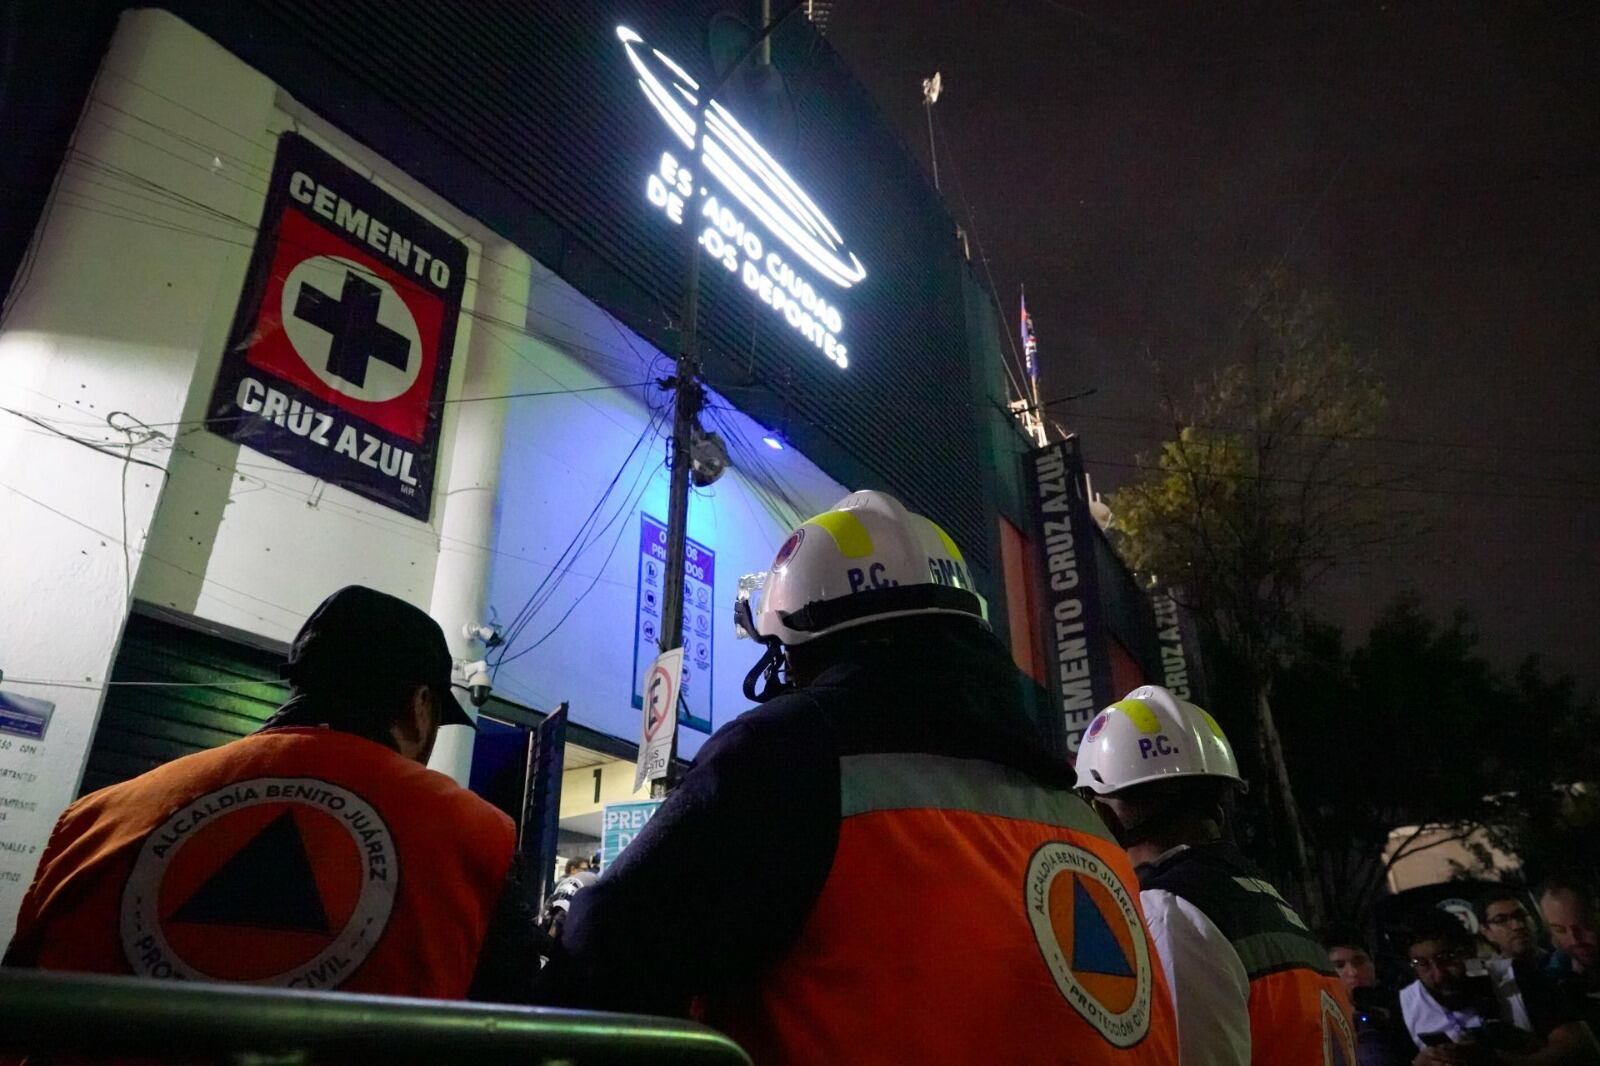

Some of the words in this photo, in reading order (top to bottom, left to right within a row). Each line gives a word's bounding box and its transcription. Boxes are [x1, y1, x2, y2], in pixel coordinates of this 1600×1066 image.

[289, 171, 450, 289] CEMENTO
[660, 152, 763, 260] ESADIO
[766, 253, 843, 333] CIUDAD
[647, 174, 684, 225] DE
[698, 228, 738, 272] OS
[743, 260, 848, 369] DEPORTES
[236, 377, 336, 447] CRUZ
[335, 426, 417, 486] AZUL
[1036, 444, 1069, 514] AZUL
[847, 562, 898, 592] P.C.
[1043, 514, 1080, 592] CRUZ
[1054, 598, 1094, 754] CEMENTO
[1160, 643, 1191, 701] CRUZ
[1138, 735, 1179, 759] P.C.
[152, 786, 258, 860] ALCALDÍA
[265, 784, 345, 811] BENITO
[343, 809, 387, 882] JUÁREZ
[1035, 851, 1056, 915] ALCALDÍA
[1056, 852, 1098, 874] BENITO
[1100, 870, 1138, 927] JUÁREZ
[1069, 985, 1134, 1038] PROTECCIÓN
